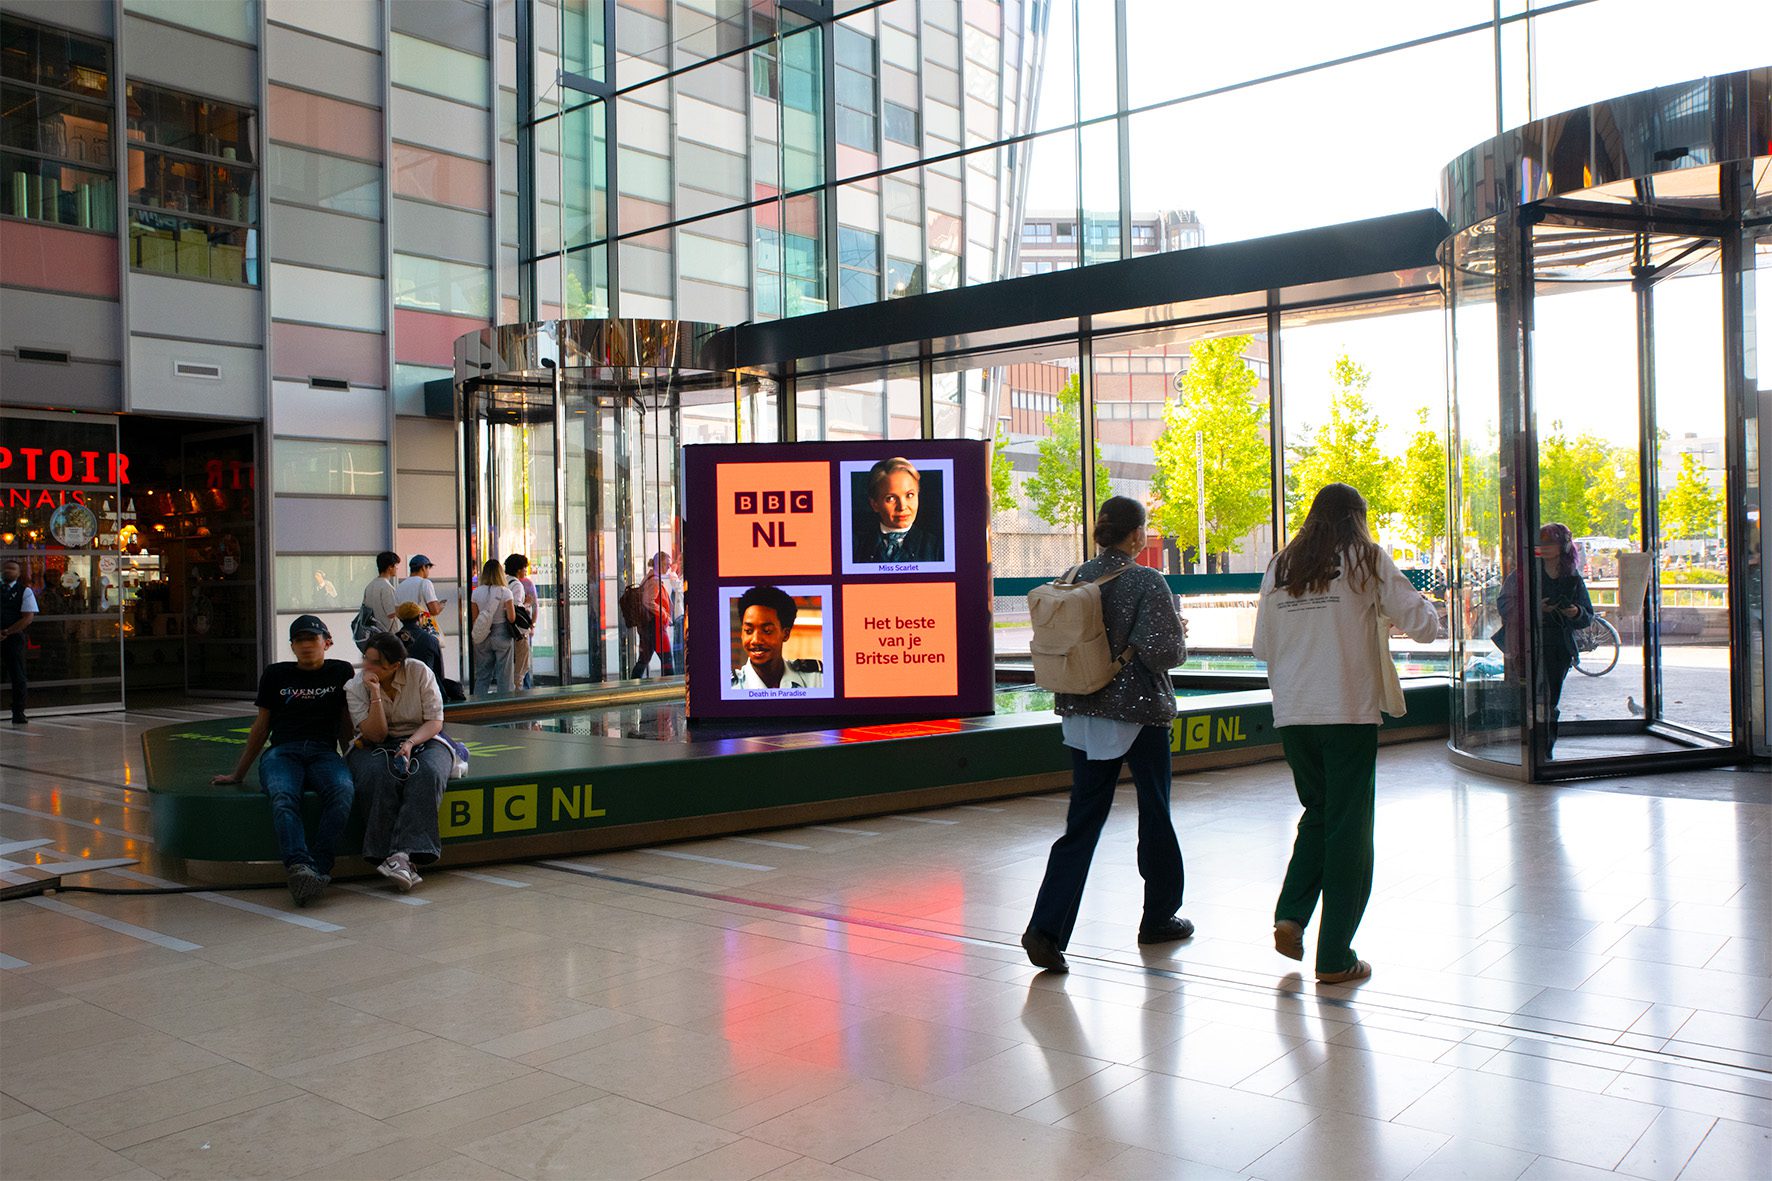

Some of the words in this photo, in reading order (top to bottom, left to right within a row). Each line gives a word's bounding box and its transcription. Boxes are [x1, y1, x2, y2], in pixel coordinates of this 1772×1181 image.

[0, 488, 86, 508] NAIS
[737, 492, 811, 513] BBC
[752, 521, 797, 548] NL
[878, 564, 894, 572] Miss
[895, 564, 919, 572] Scarlet
[864, 616, 891, 630] Het
[895, 616, 936, 629] beste
[878, 636, 905, 647] van
[907, 633, 922, 650] je
[855, 651, 899, 665] Britse
[903, 650, 946, 664] buren
[279, 686, 337, 698] GIVENCHY
[748, 690, 769, 698] Death
[1216, 715, 1247, 743] NL
[551, 783, 607, 821] NL
